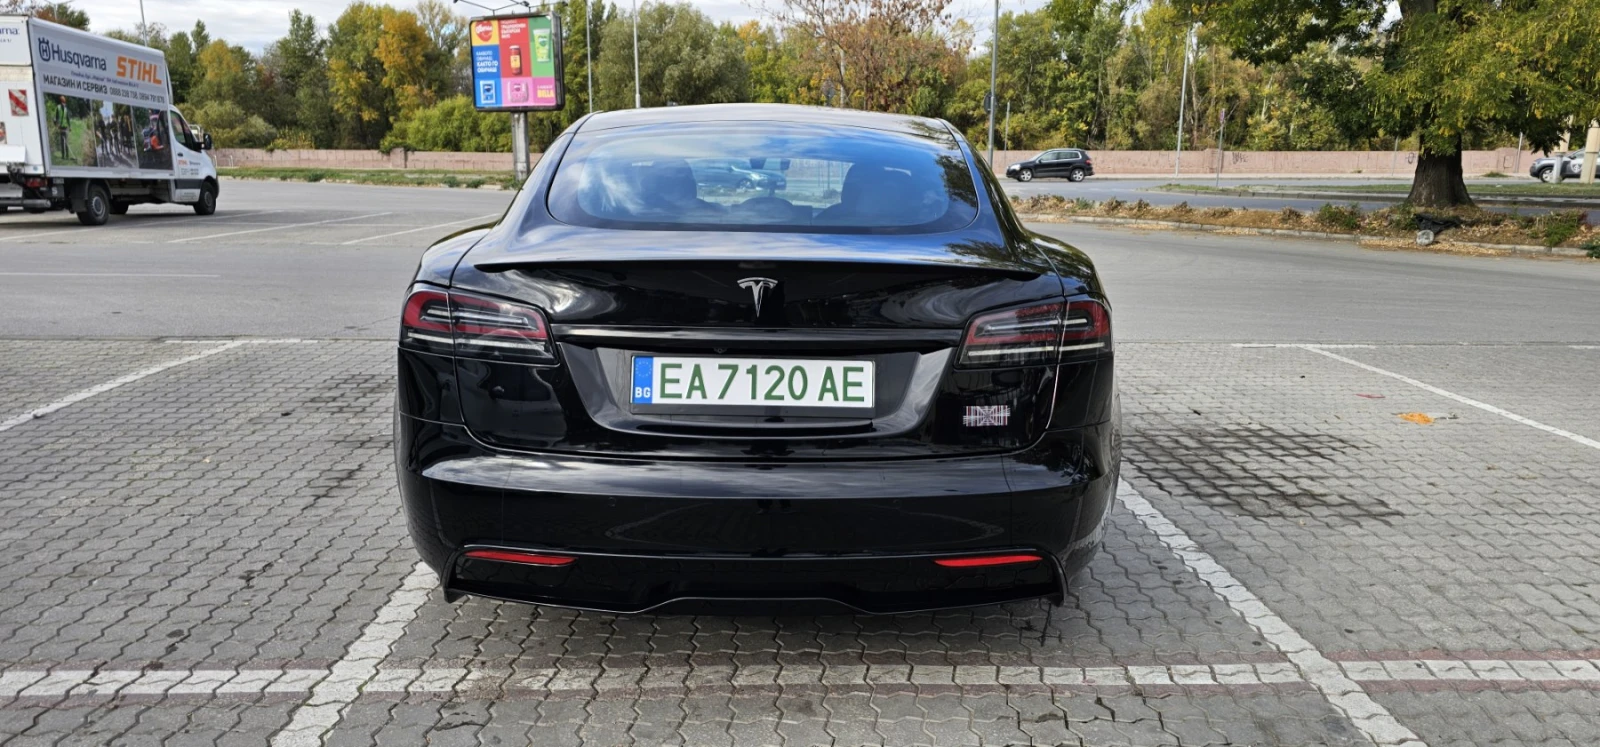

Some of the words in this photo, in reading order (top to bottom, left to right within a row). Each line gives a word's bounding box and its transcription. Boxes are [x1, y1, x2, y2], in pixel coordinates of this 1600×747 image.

[51, 43, 107, 71] Husqvarna
[116, 55, 162, 85] STIHL
[43, 74, 76, 88] МАГАЗИН
[76, 80, 83, 90] И
[83, 81, 108, 95] СЕРВИЗ
[634, 387, 651, 399] BG
[659, 363, 708, 400] EA
[717, 363, 808, 401] 7120
[817, 365, 865, 402] AE
